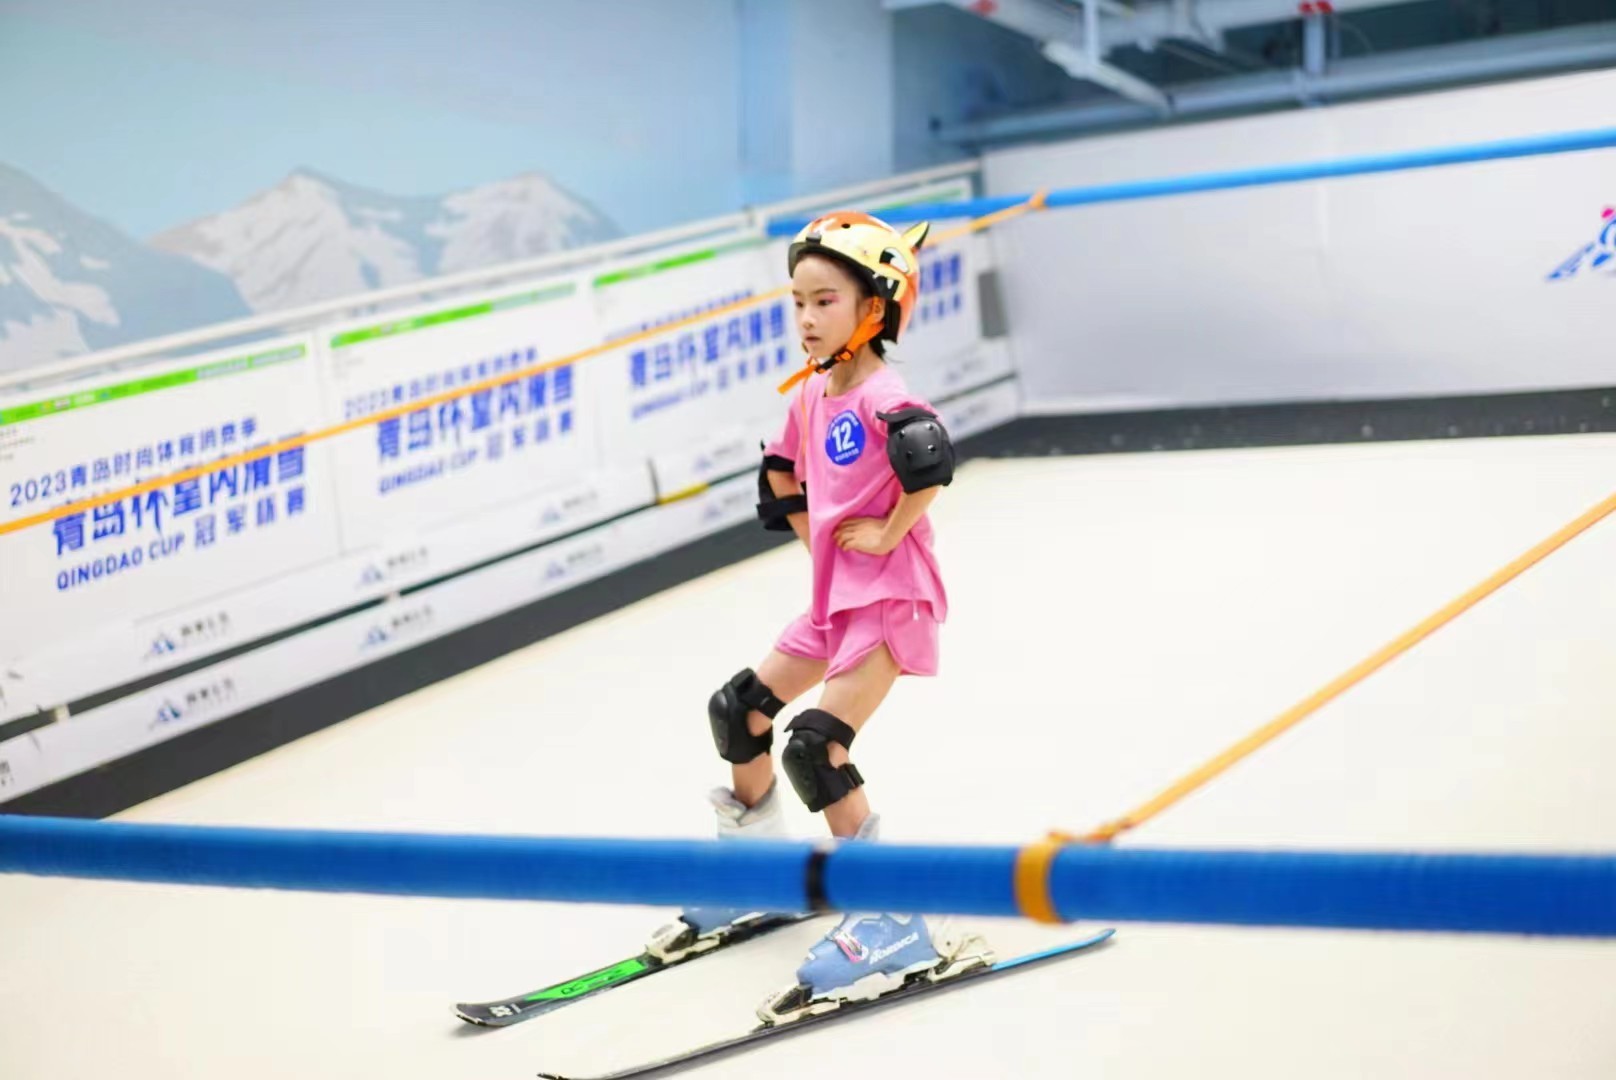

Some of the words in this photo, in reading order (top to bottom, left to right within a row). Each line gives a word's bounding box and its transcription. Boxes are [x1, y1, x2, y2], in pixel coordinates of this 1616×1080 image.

[832, 421, 856, 453] 12
[57, 546, 143, 590] QINGDAO
[148, 533, 185, 560] CUP
